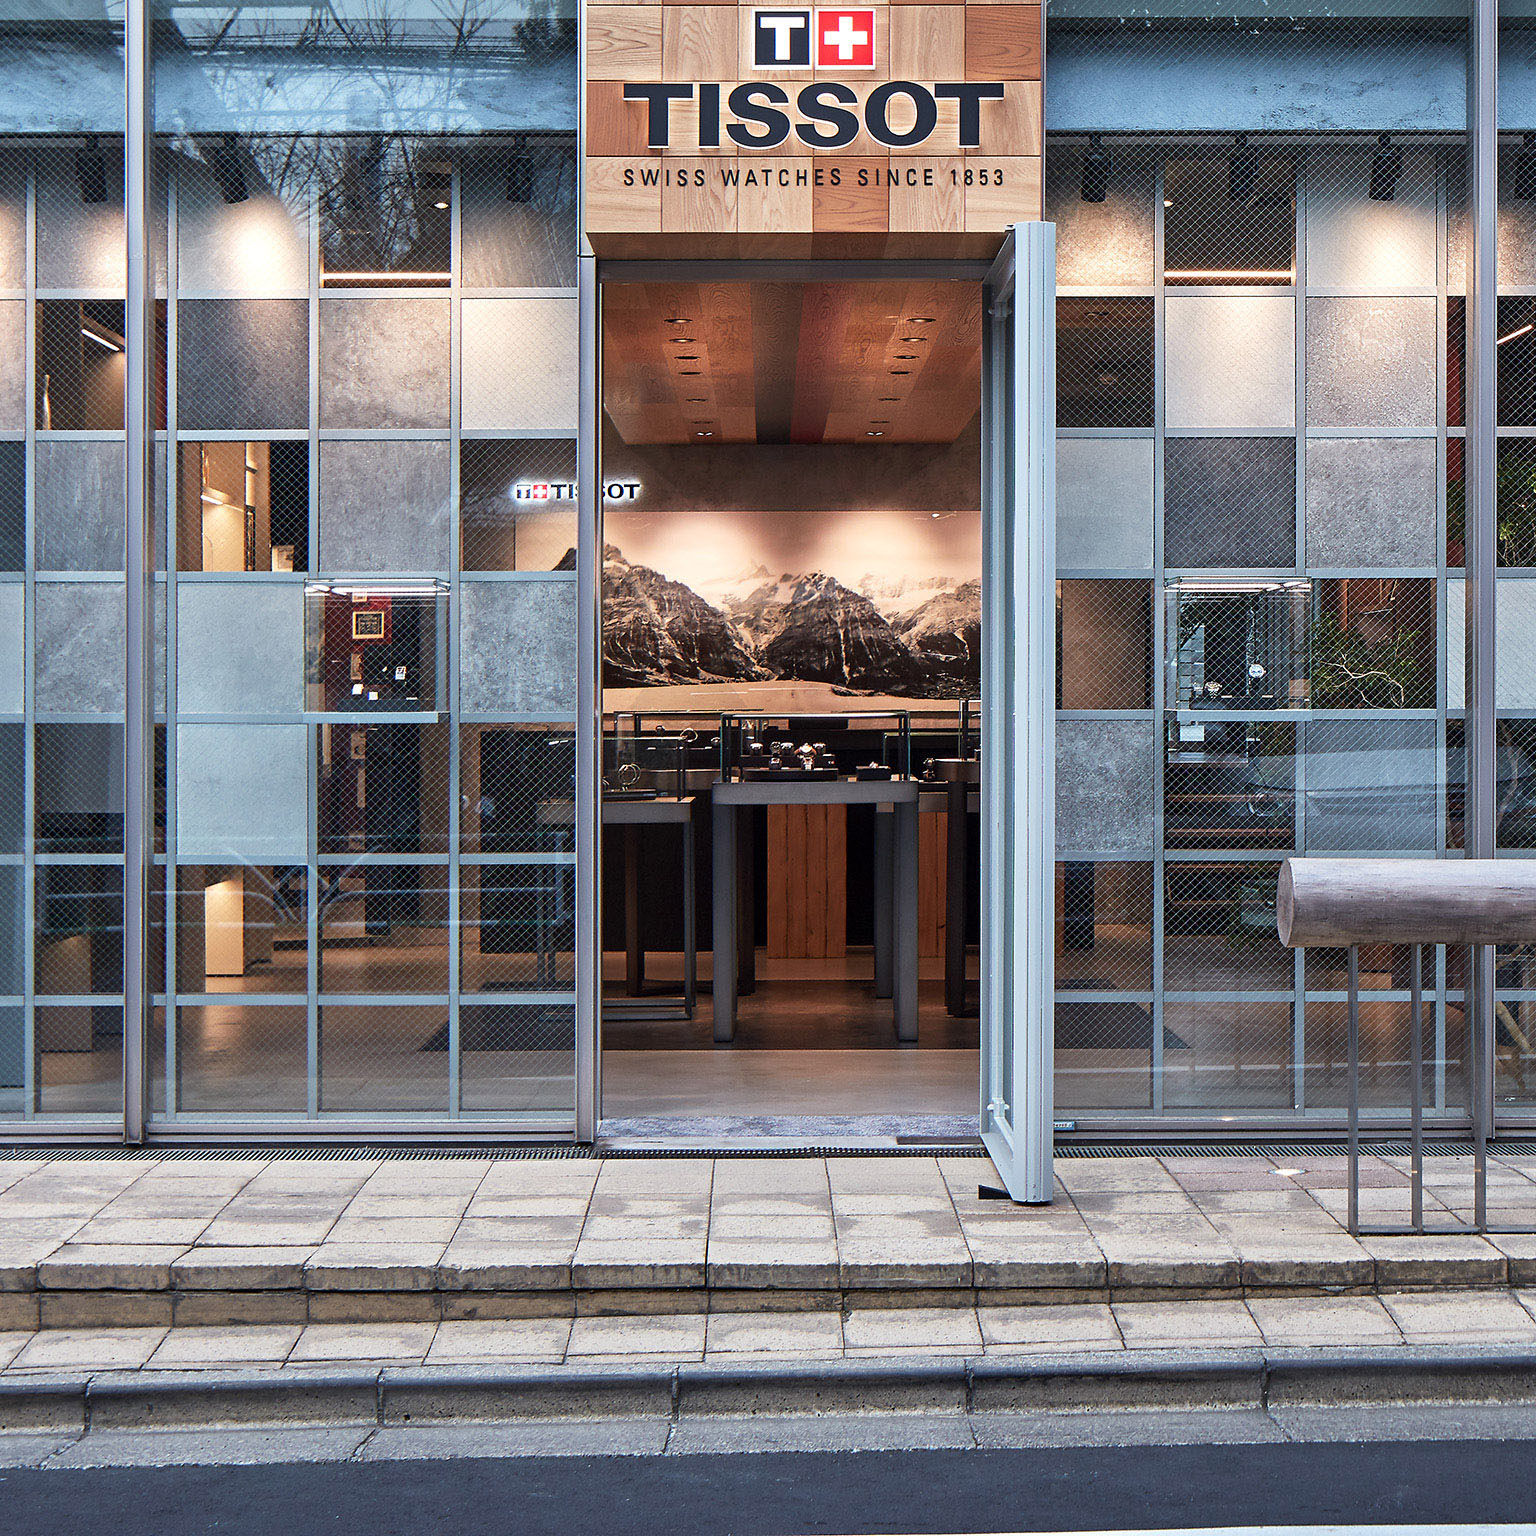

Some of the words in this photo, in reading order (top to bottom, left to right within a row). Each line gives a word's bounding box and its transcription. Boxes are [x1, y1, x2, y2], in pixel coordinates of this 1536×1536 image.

[623, 81, 1004, 149] TISSOT
[624, 168, 705, 187] SWISS
[721, 168, 841, 187] WATCHES
[858, 168, 933, 187] SINCE
[950, 168, 1004, 187] 1853
[551, 483, 640, 499] TIOT
